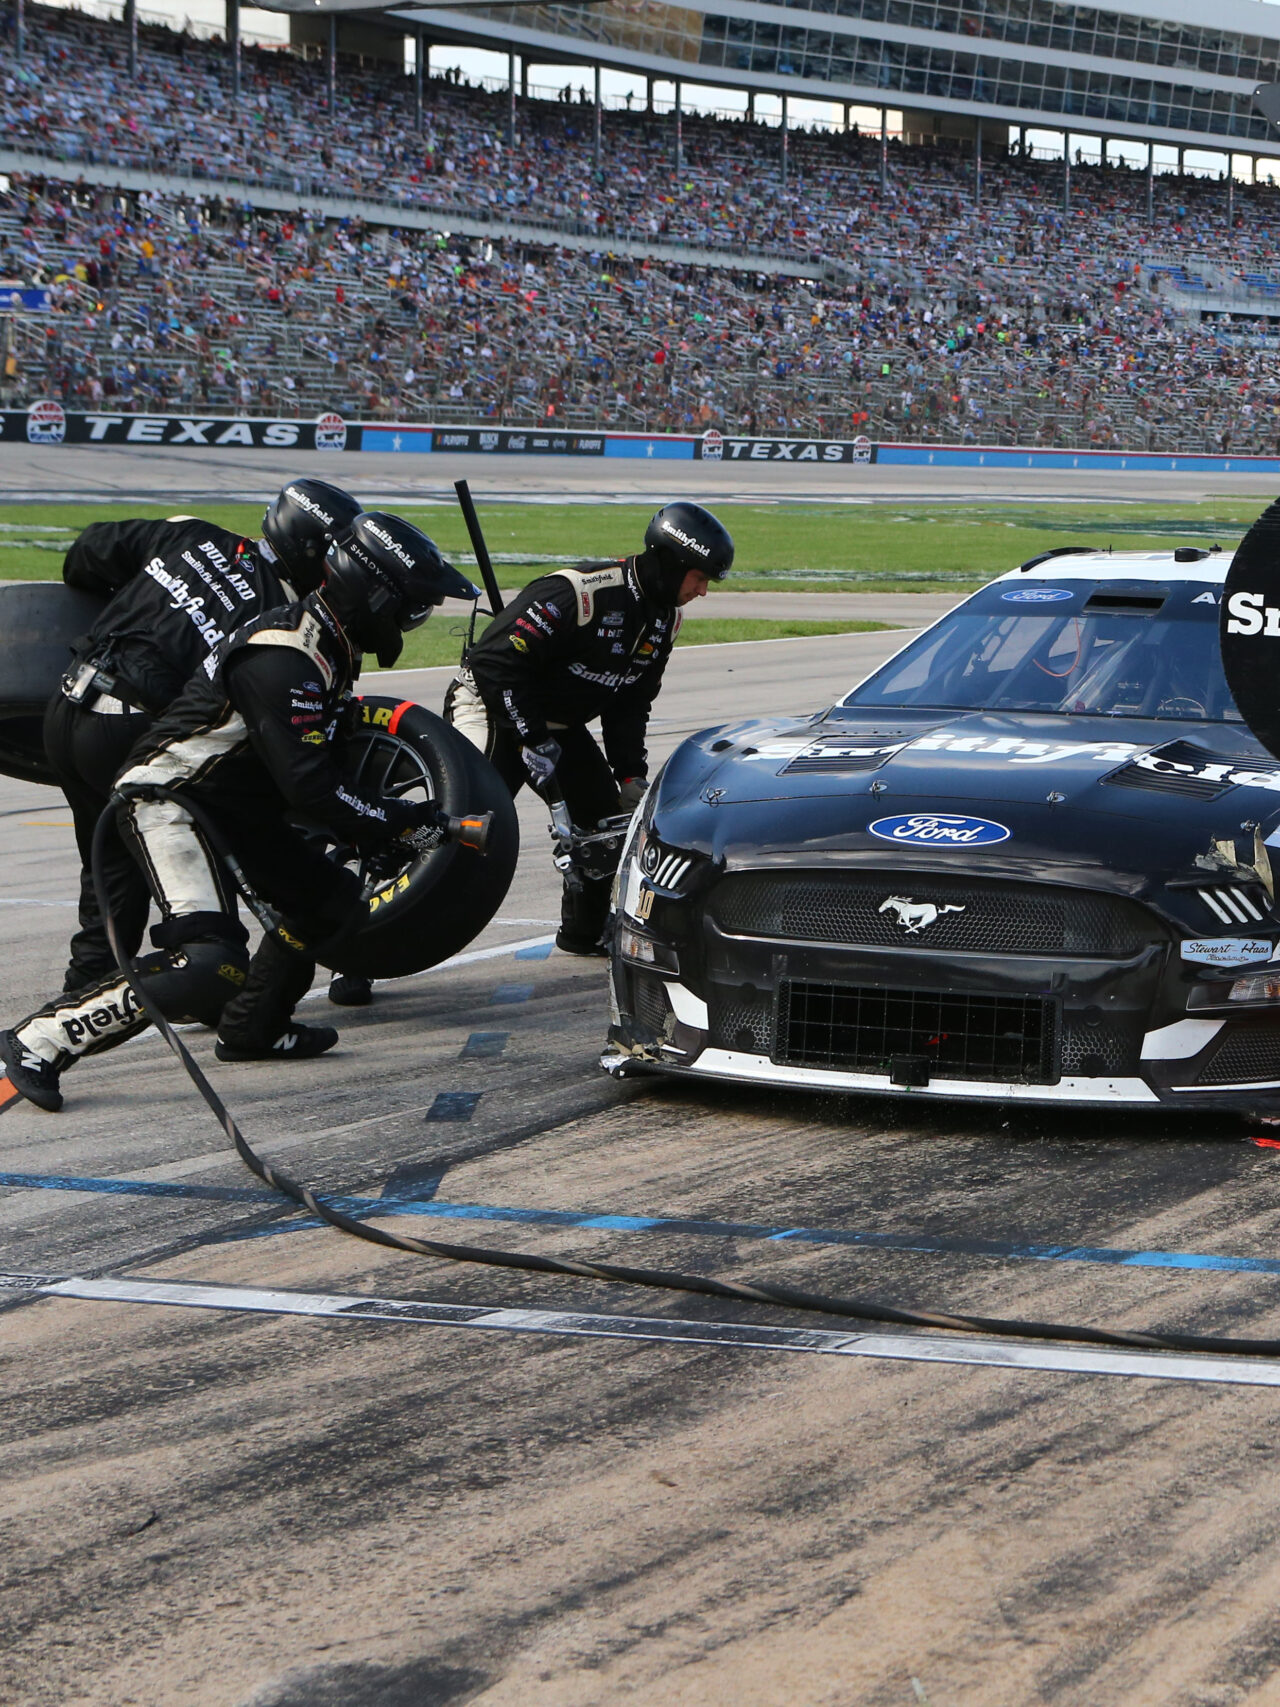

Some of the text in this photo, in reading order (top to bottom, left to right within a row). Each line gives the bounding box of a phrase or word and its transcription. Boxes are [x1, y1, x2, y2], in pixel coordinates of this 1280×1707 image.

[85, 416, 299, 446] TEXAS
[479, 432, 499, 445] BUSCH
[729, 442, 843, 461] TEXAS
[285, 486, 334, 526] Smithfield
[363, 519, 416, 570] Smithfield
[662, 520, 710, 557] Smithfield
[144, 556, 225, 650] Smithfield
[1191, 591, 1217, 604] A
[892, 816, 989, 843] Ford
[635, 888, 656, 920] 10
[1184, 942, 1233, 954] Stewart
[1241, 941, 1269, 954] Haas
